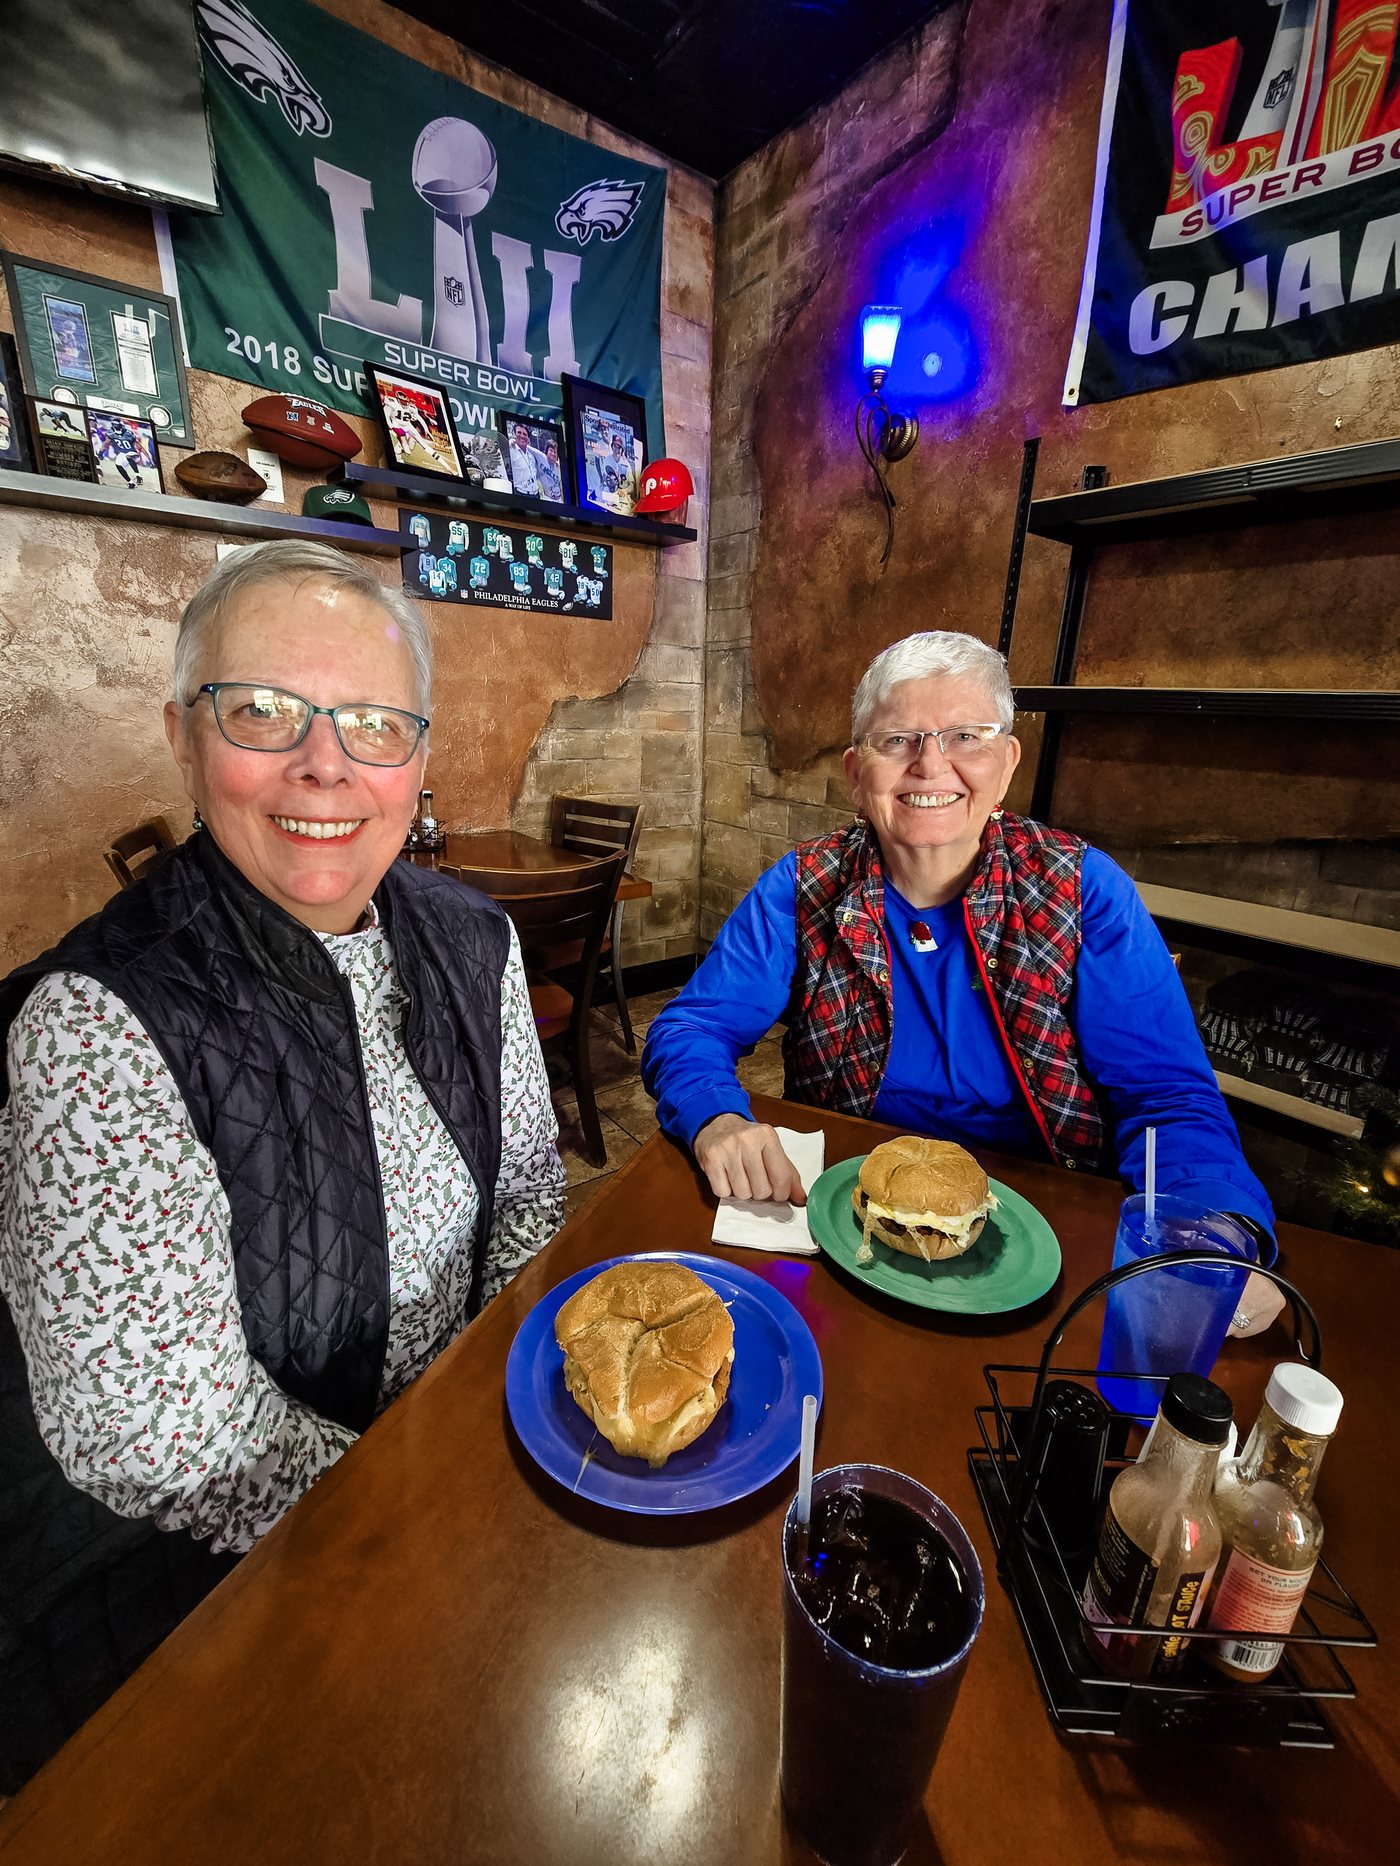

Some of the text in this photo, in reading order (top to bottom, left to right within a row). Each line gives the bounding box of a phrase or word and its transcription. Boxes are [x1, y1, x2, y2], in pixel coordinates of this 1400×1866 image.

[1265, 82, 1289, 106] NFL
[1179, 138, 1400, 236] SUPER B
[445, 287, 464, 303] NFL
[224, 327, 498, 431] 2018 SUP OWL
[384, 342, 541, 401] SUPER BOWL
[291, 399, 327, 417] EAGLES
[394, 410, 412, 421] 12
[114, 439, 132, 450] 20
[474, 590, 559, 608] PHILADELPHIA EAGLES
